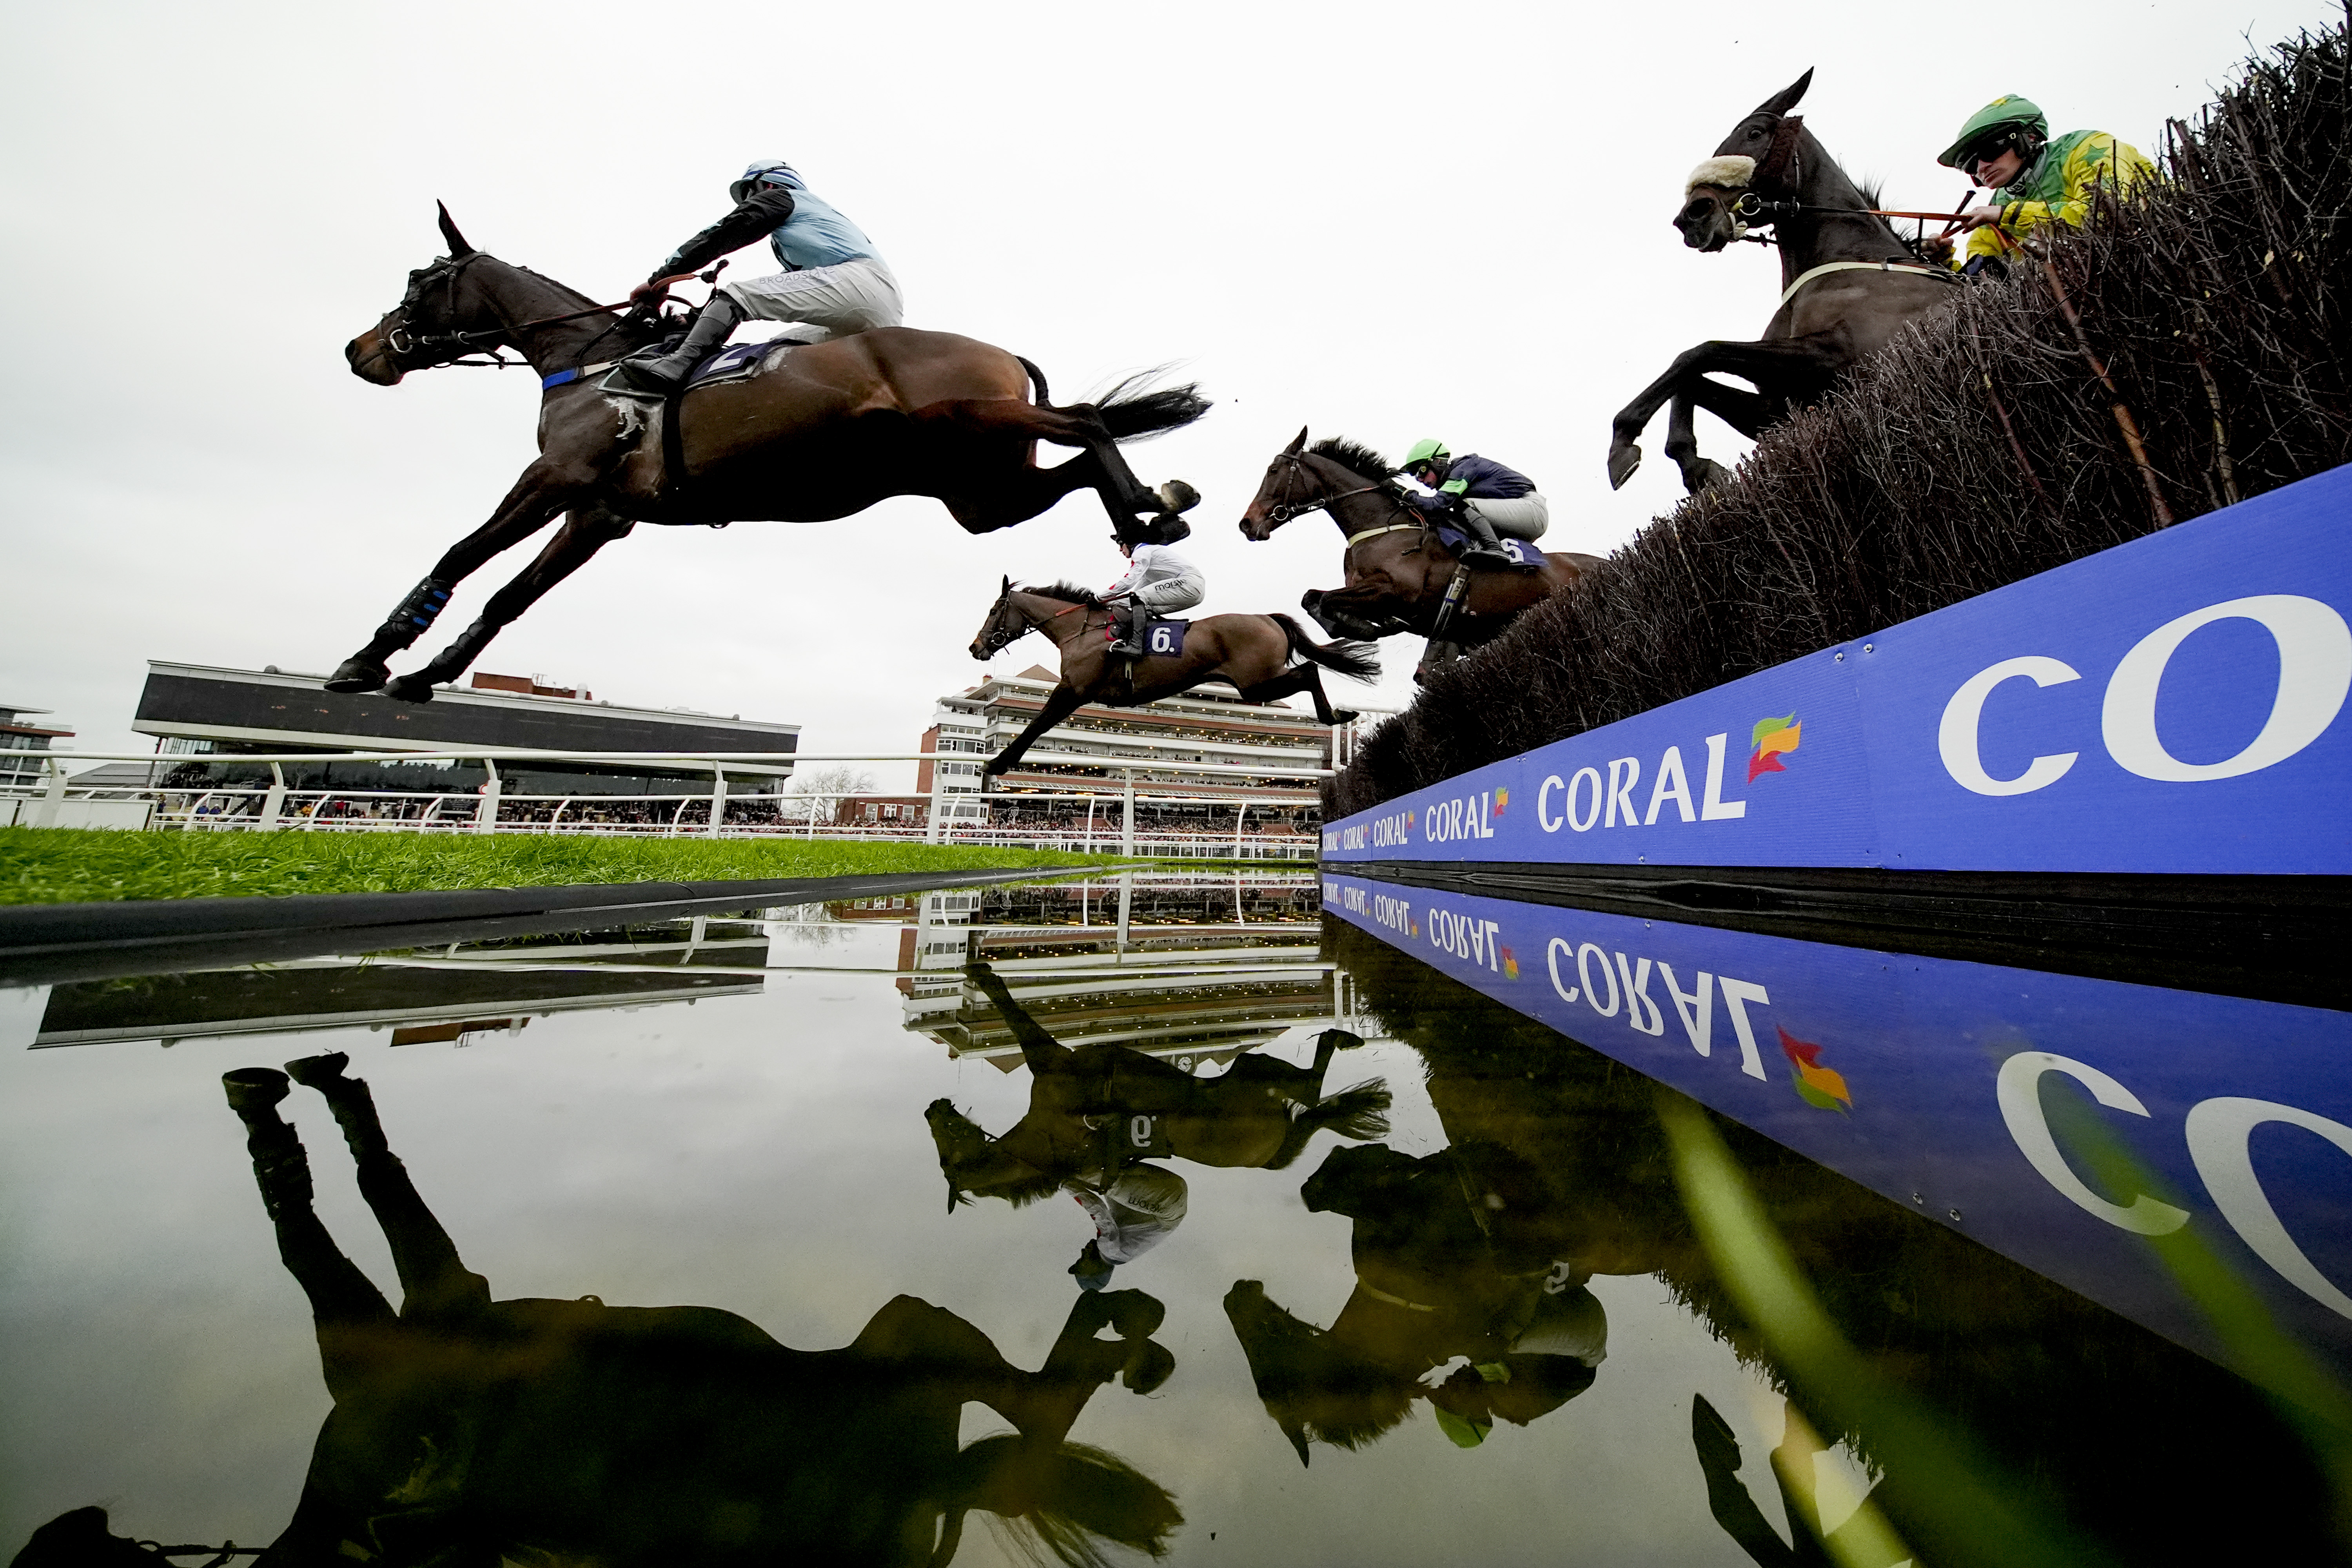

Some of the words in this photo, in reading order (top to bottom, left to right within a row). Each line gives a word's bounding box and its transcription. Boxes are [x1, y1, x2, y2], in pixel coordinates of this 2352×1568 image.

[1500, 538, 1524, 563] 5
[1323, 831, 1338, 851] CORAL
[1344, 824, 1365, 850] CORAL
[1374, 812, 1408, 847] CORAL
[1426, 792, 1494, 842] CORAL
[1538, 733, 1746, 833] CORAL
[1938, 595, 2352, 796] CO
